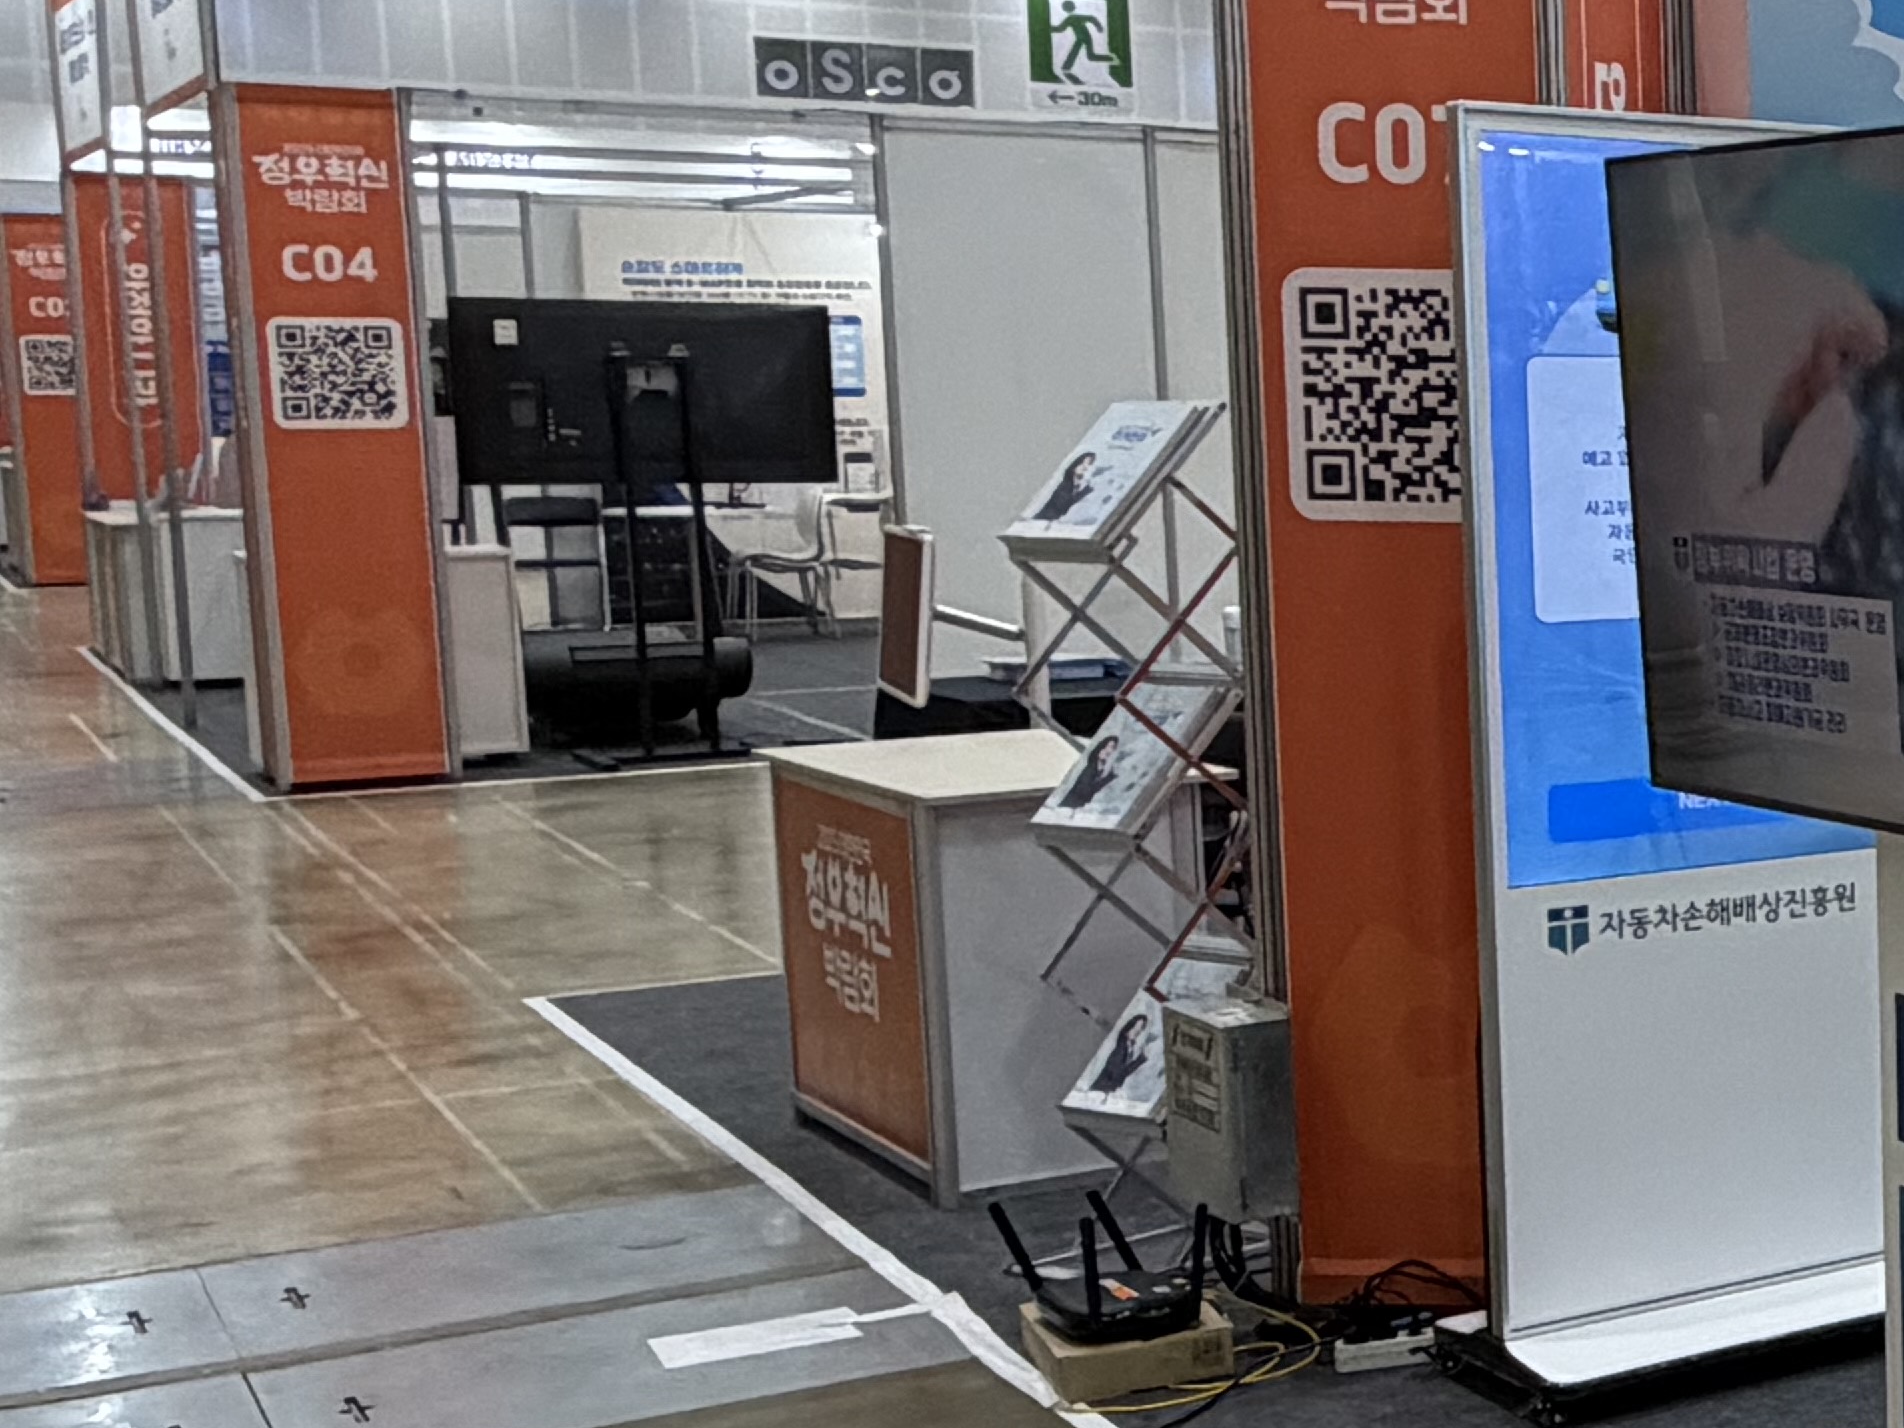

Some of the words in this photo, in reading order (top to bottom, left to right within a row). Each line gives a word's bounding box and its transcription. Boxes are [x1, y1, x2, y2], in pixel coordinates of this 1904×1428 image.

[1078, 91, 1119, 107] 30m
[1317, 101, 1447, 185] C0
[284, 189, 367, 213] 박람회
[281, 244, 378, 283] C04
[28, 297, 70, 319] C0
[1600, 882, 1856, 939] 자동차손해배상진흥원
